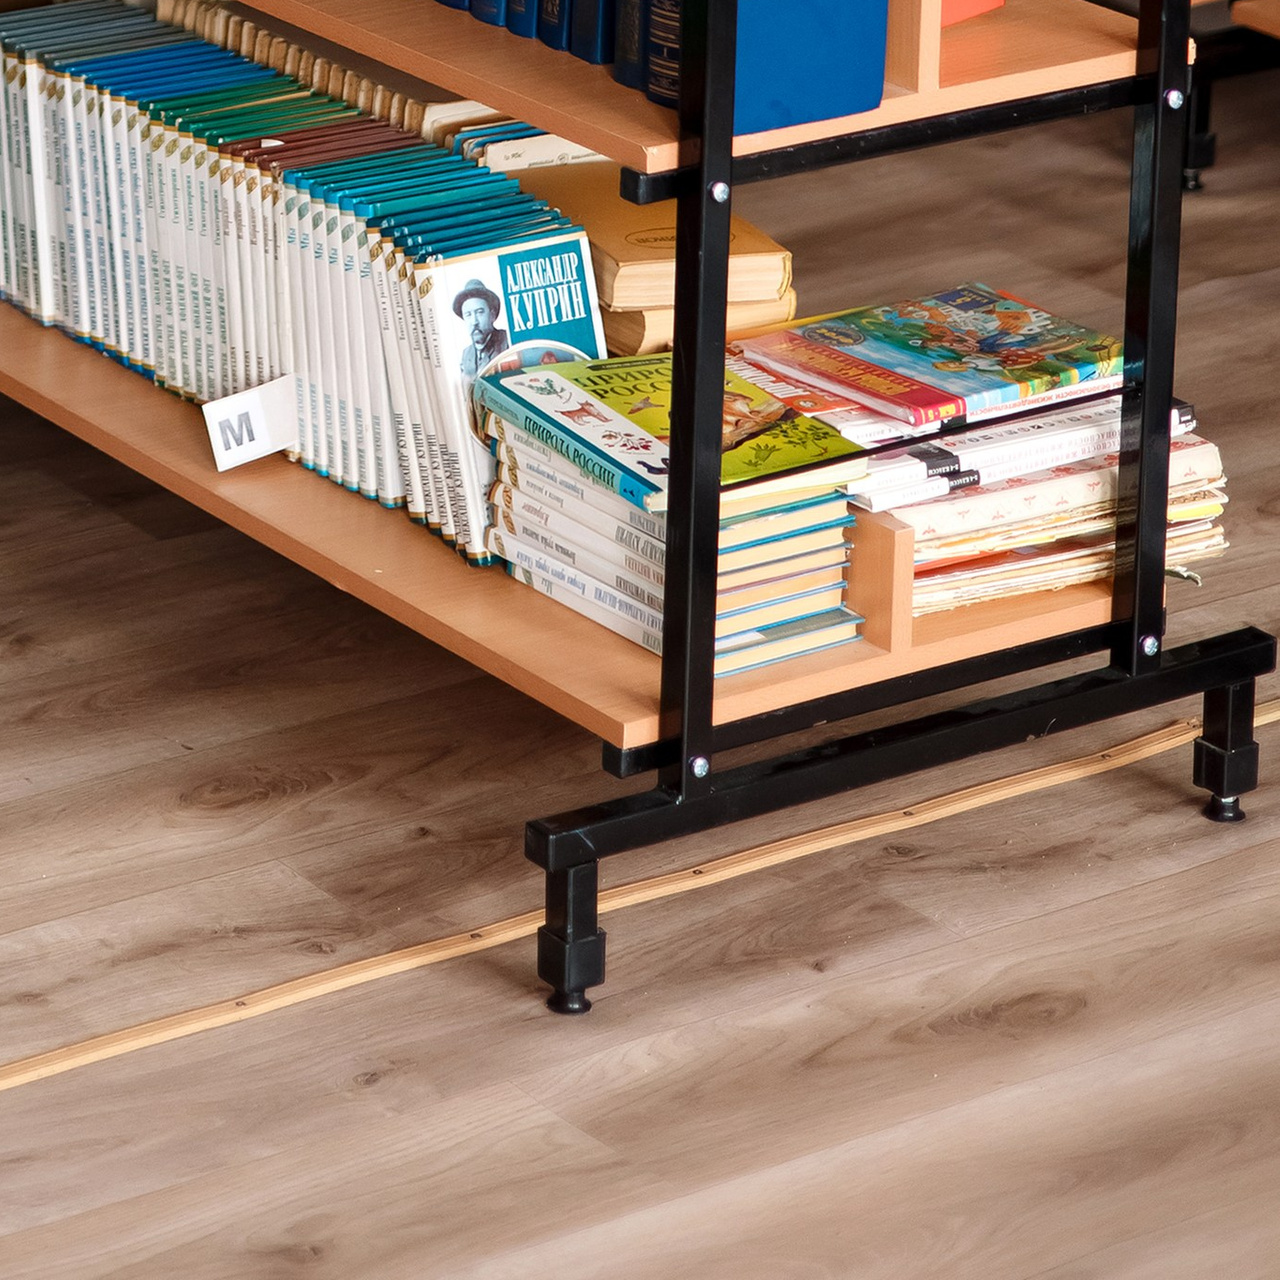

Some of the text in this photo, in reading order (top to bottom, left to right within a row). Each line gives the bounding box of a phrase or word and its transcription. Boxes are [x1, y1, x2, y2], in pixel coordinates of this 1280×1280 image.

[287, 227, 296, 243] Мы
[299, 232, 310, 249] Мы
[313, 242, 323, 259] Мы
[328, 247, 338, 264] Мы
[343, 254, 353, 271] Мы
[360, 261, 370, 278] Мы
[506, 252, 579, 293] АЛЕКСАНДР
[508, 281, 587, 332] КУПРИН
[573, 365, 672, 388] ПРИРО
[591, 380, 672, 399] РОСС
[218, 411, 255, 451] М
[394, 411, 415, 506] АЛЕКСАНДР КУПРИН
[524, 416, 616, 488] ПРИРОДА РОССИИ
[412, 422, 434, 516] АЛЕКСАНДР КУПРИН
[427, 433, 448, 527] АЛЕКСАНДР КУПРИН
[449, 450, 472, 546] АЛЕКСАНДР КУПРИН
